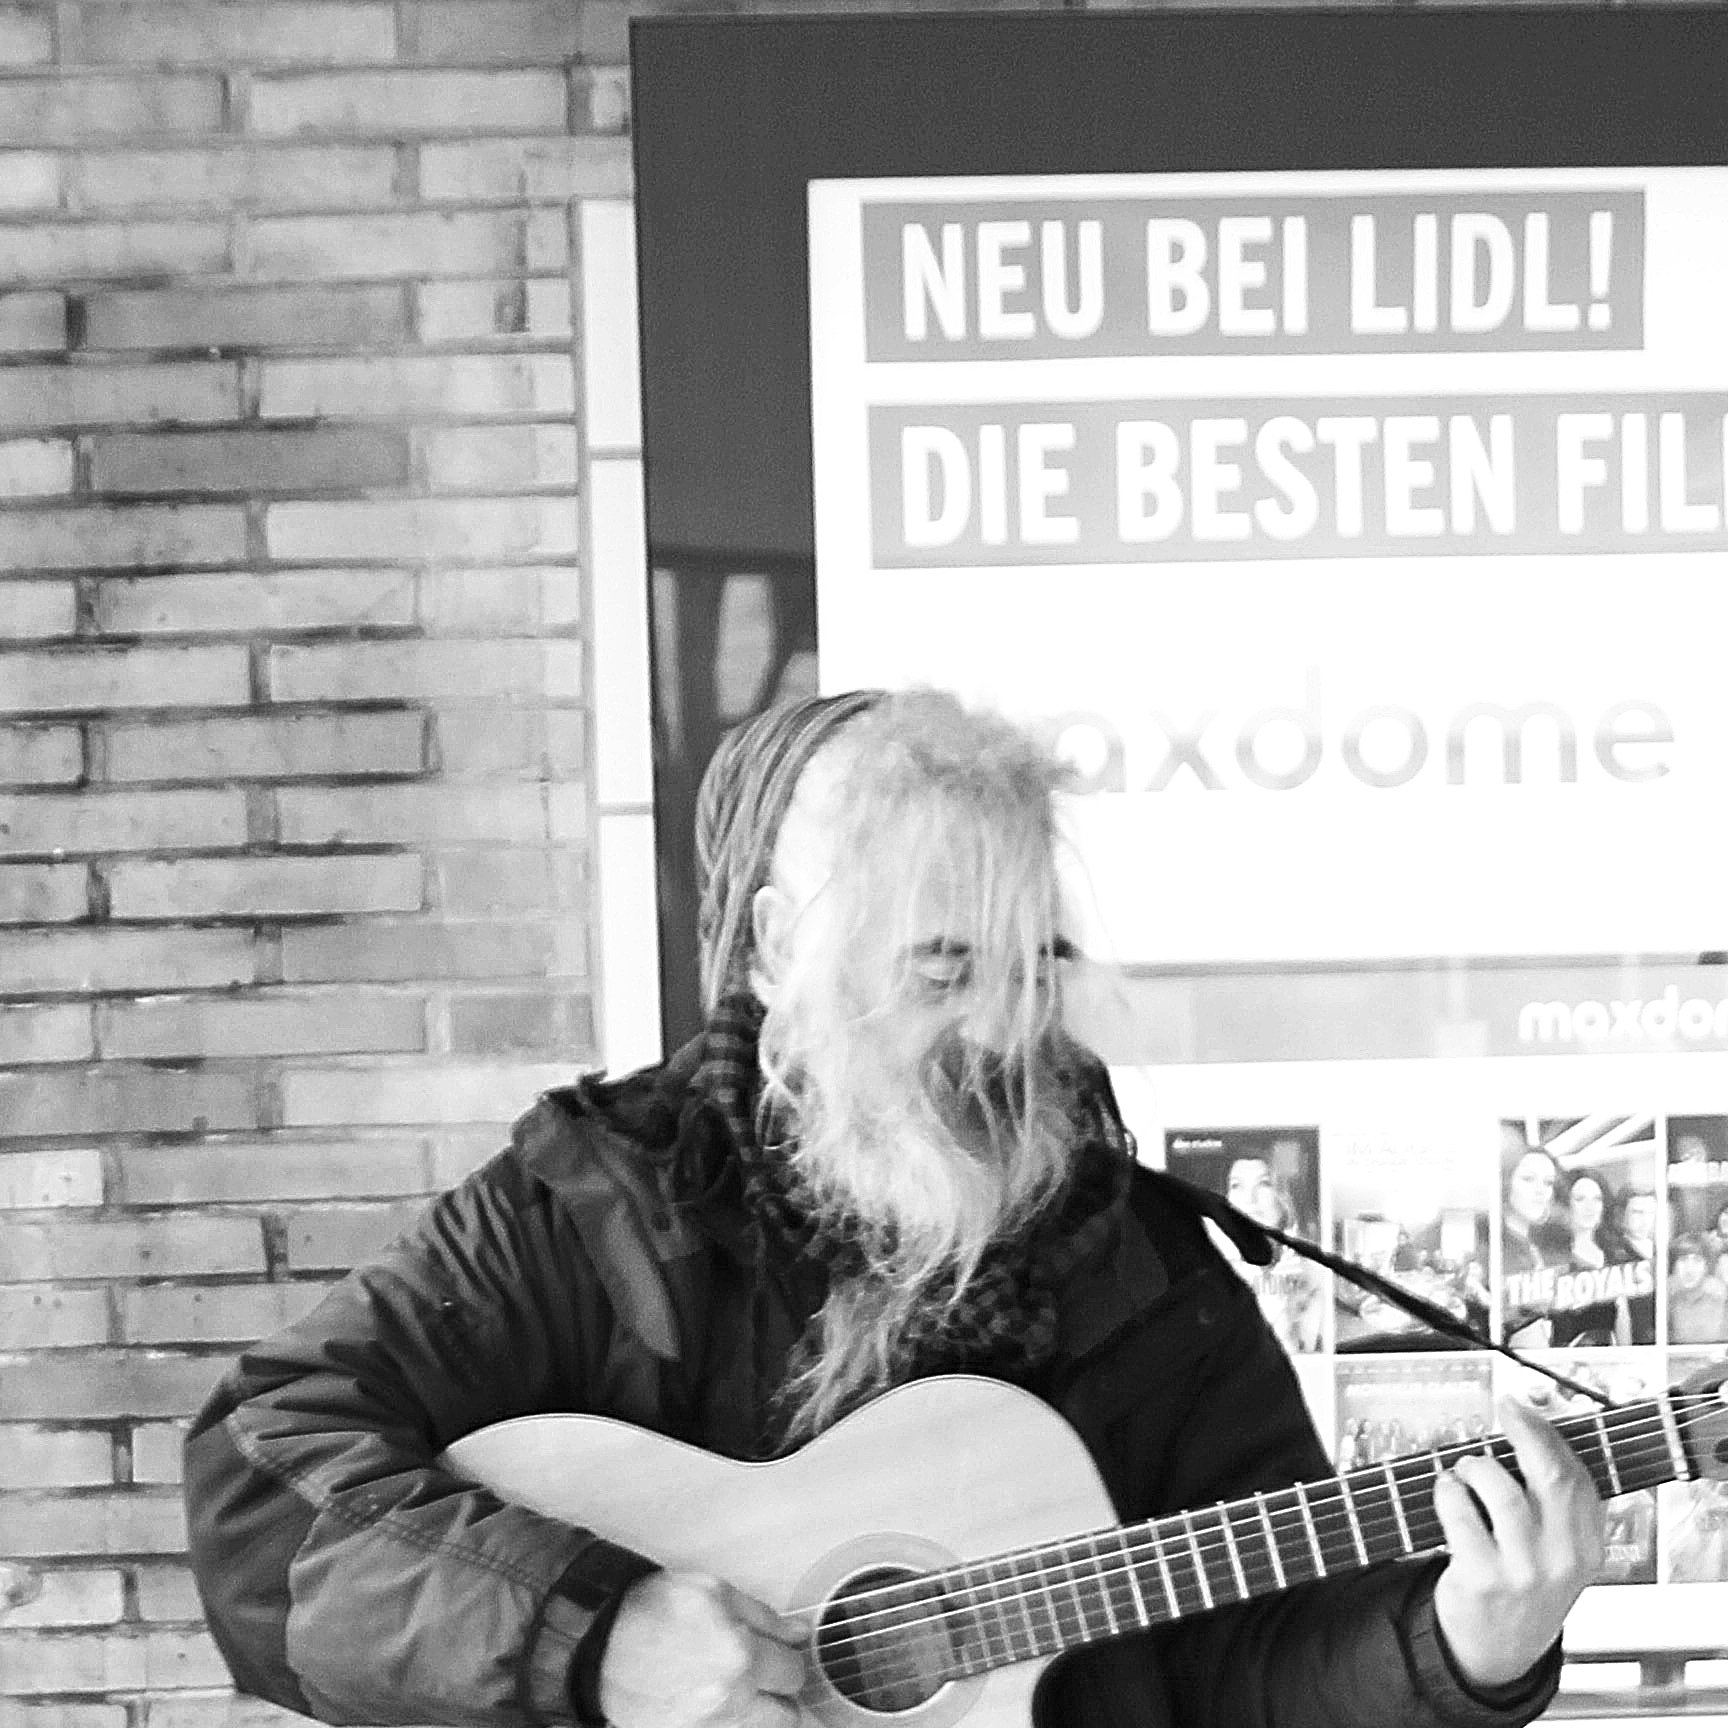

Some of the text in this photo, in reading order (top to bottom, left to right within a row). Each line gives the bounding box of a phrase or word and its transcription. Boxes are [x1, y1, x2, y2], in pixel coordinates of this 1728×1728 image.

[901, 210, 1613, 342] NEU BEI LIDL!
[901, 423, 1079, 548] DIE
[1116, 413, 1514, 544] BESTEN
[1046, 666, 1674, 797] axdome
[1507, 1260, 1654, 1310] THE ROYALS
